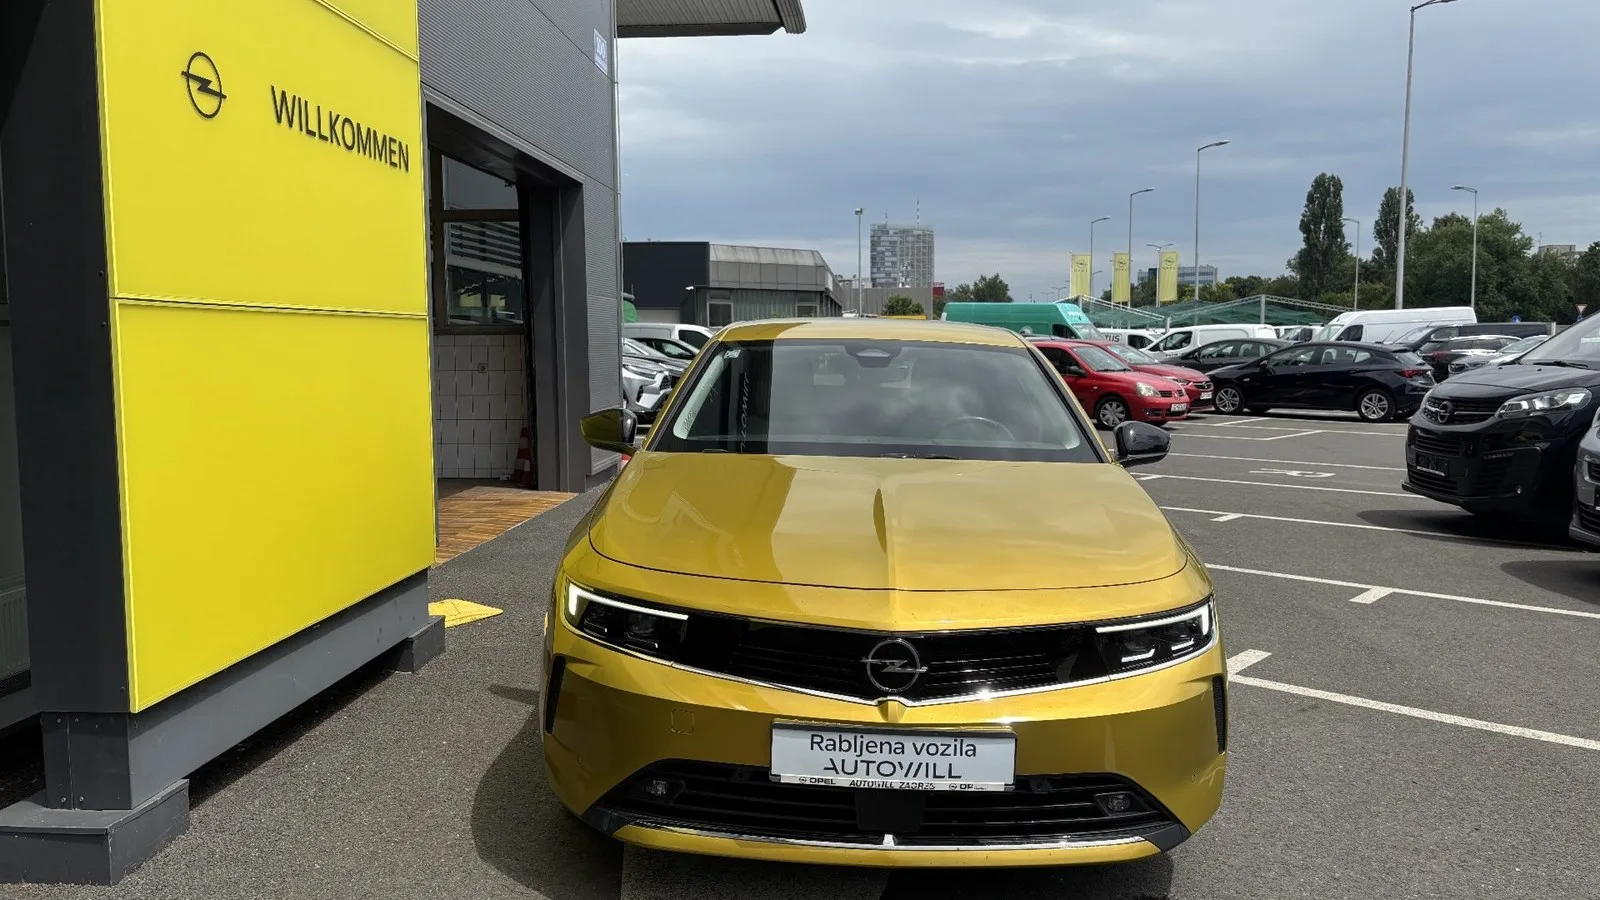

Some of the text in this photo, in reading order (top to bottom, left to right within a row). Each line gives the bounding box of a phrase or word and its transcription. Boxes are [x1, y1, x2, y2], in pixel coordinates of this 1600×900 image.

[270, 85, 410, 172] WILLKOMMEN
[810, 733, 977, 757] Rabljena vozila
[823, 758, 962, 779] AUTOWILL
[809, 777, 836, 785] OPEL
